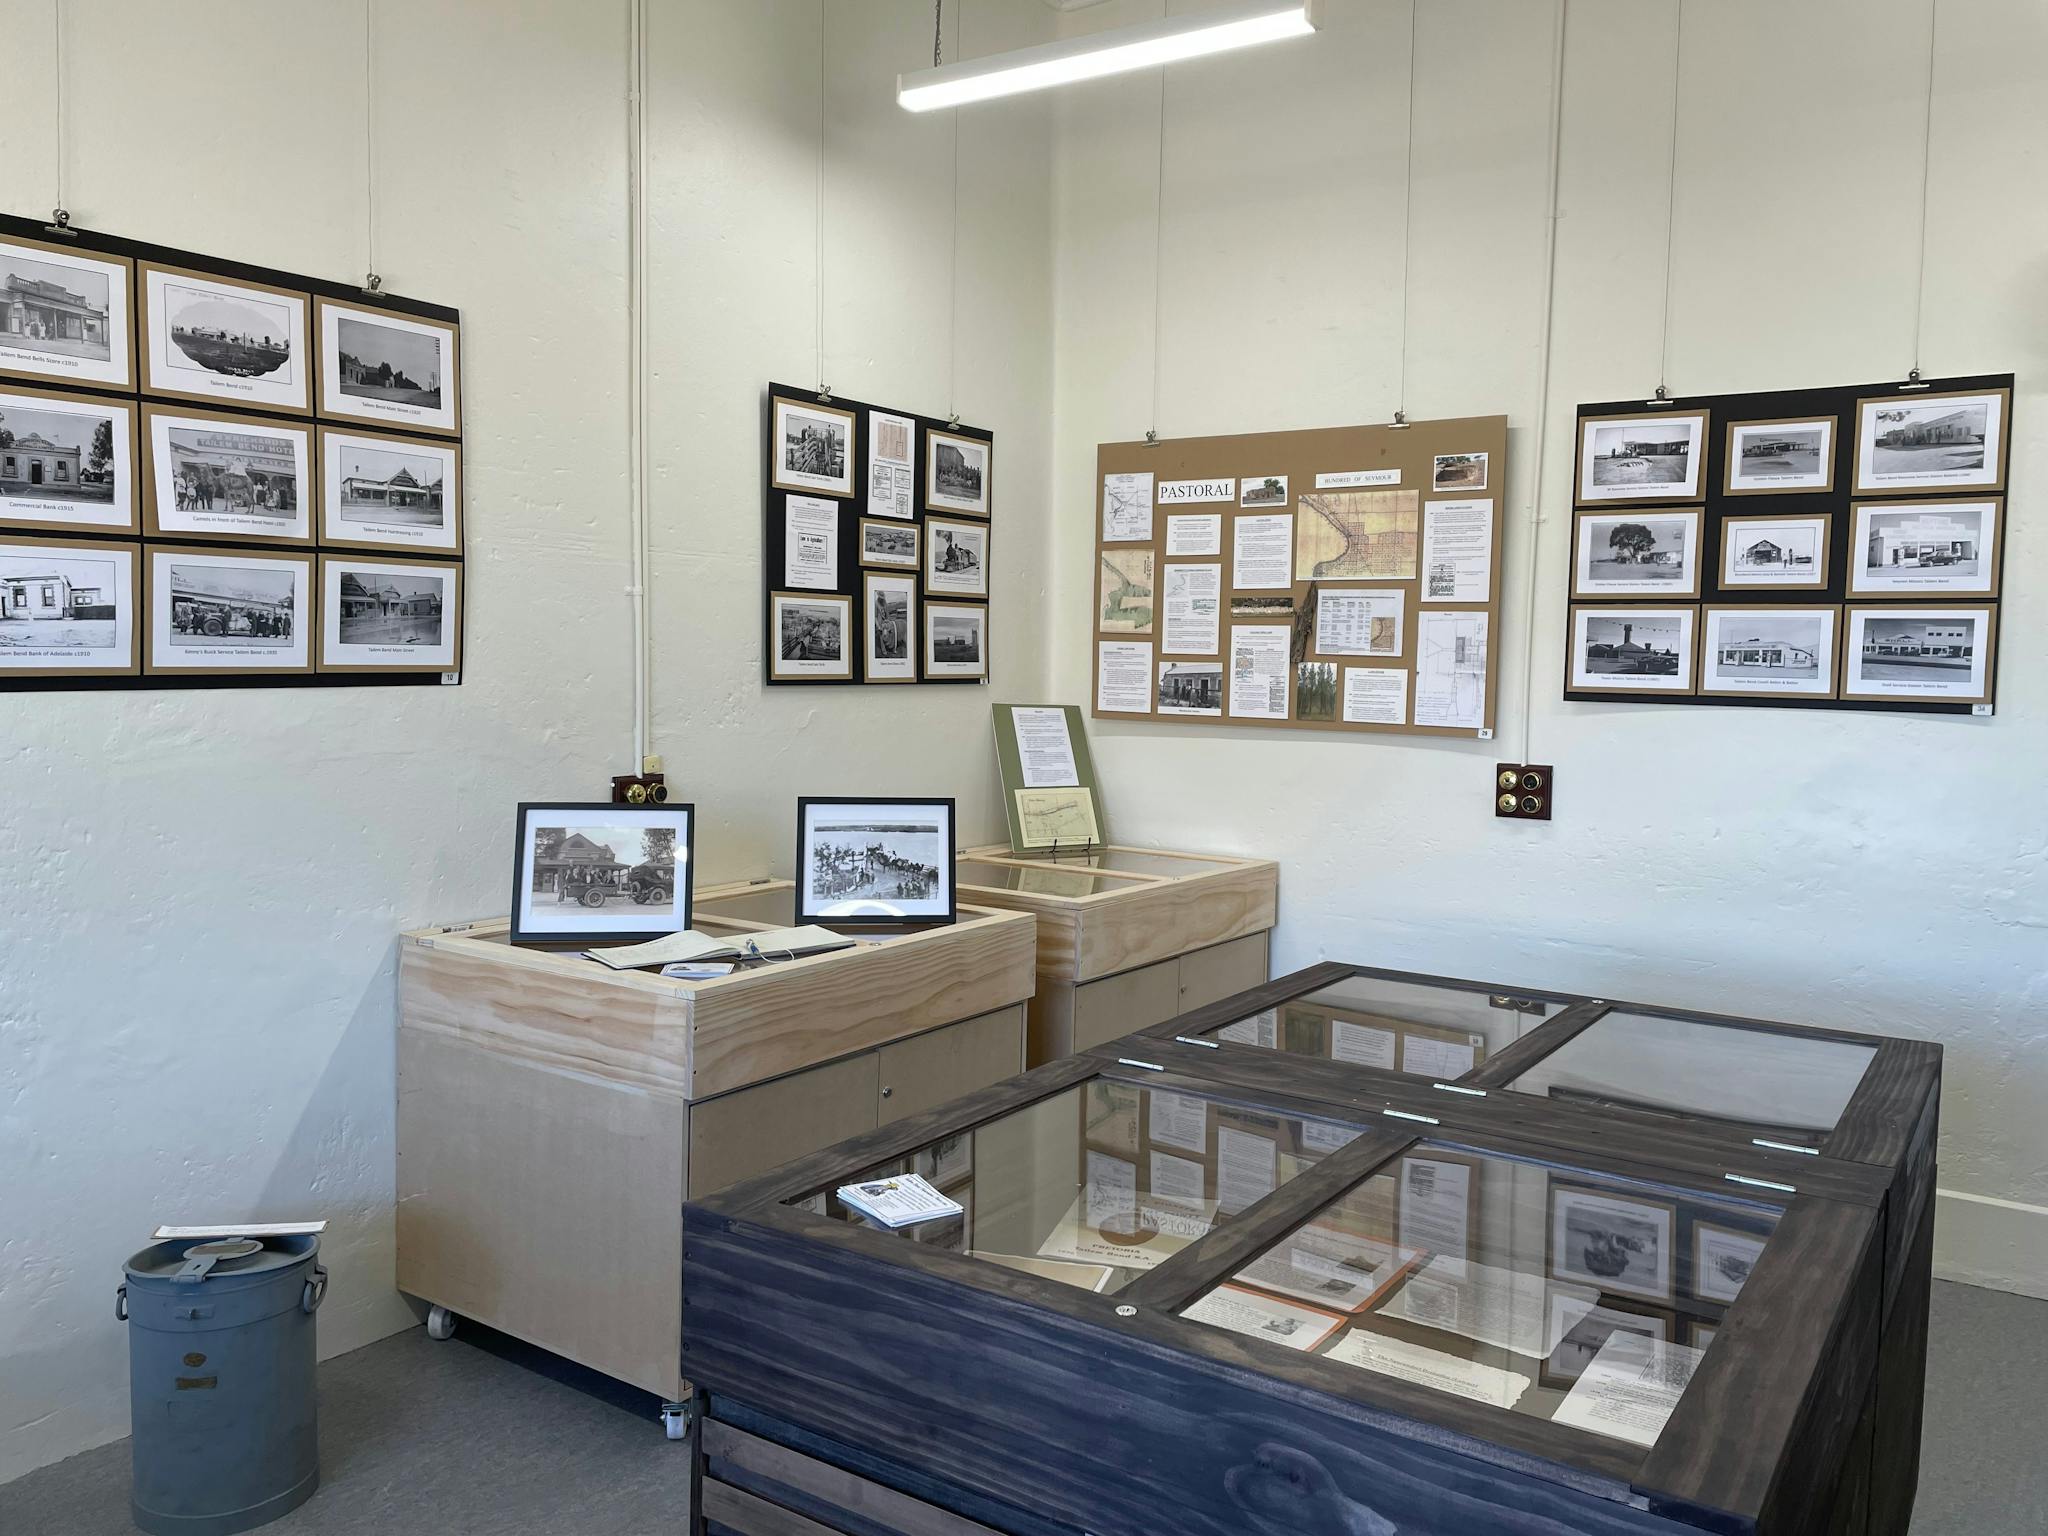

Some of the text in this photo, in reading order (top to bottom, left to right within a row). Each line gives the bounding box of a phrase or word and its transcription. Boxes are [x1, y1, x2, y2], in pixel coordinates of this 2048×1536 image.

[200, 439, 233, 449] TAILEM
[237, 443, 265, 452] BEND
[1324, 476, 1351, 484] HUNDRED
[1365, 474, 1391, 482] SEYMOUR
[1160, 483, 1233, 499] PASTORAL
[9, 501, 42, 509] Commercial
[1075, 1246, 1104, 1257] Tailem
[1106, 1250, 1132, 1260] Bend
[1091, 1243, 1141, 1254] PRETORIA
